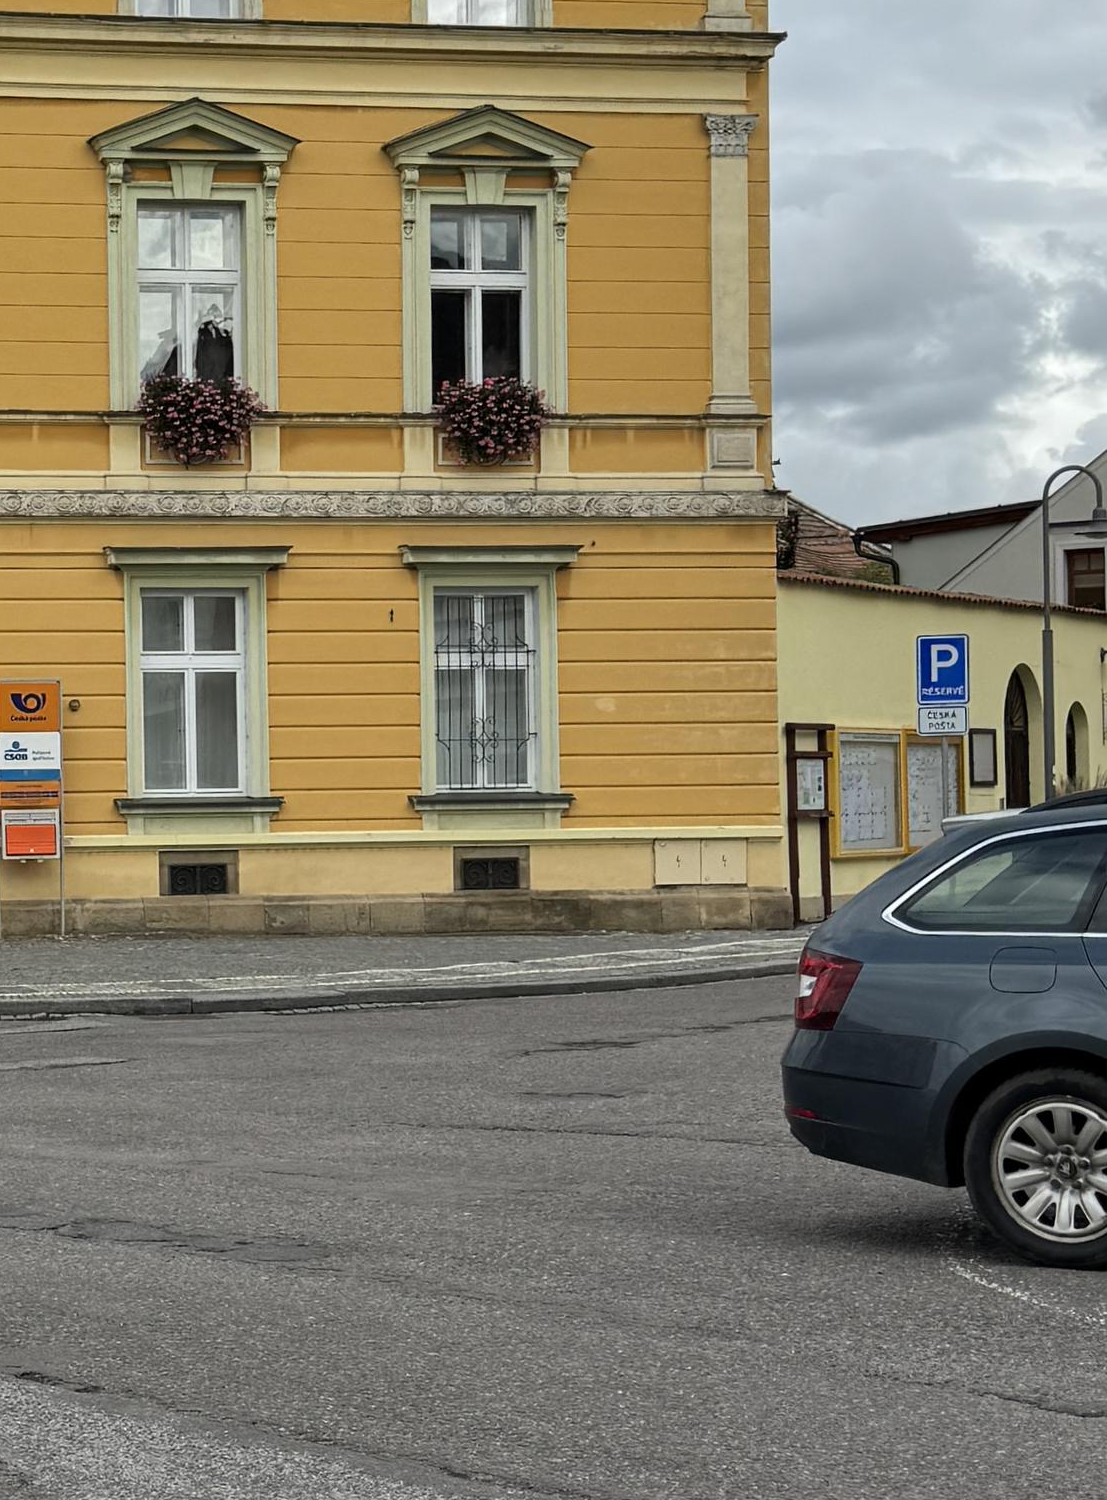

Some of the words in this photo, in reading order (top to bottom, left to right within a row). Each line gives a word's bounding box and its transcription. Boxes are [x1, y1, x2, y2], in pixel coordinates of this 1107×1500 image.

[930, 644, 958, 682] P
[927, 709, 957, 719] ČESKÁ
[928, 720, 956, 730] POŠTA
